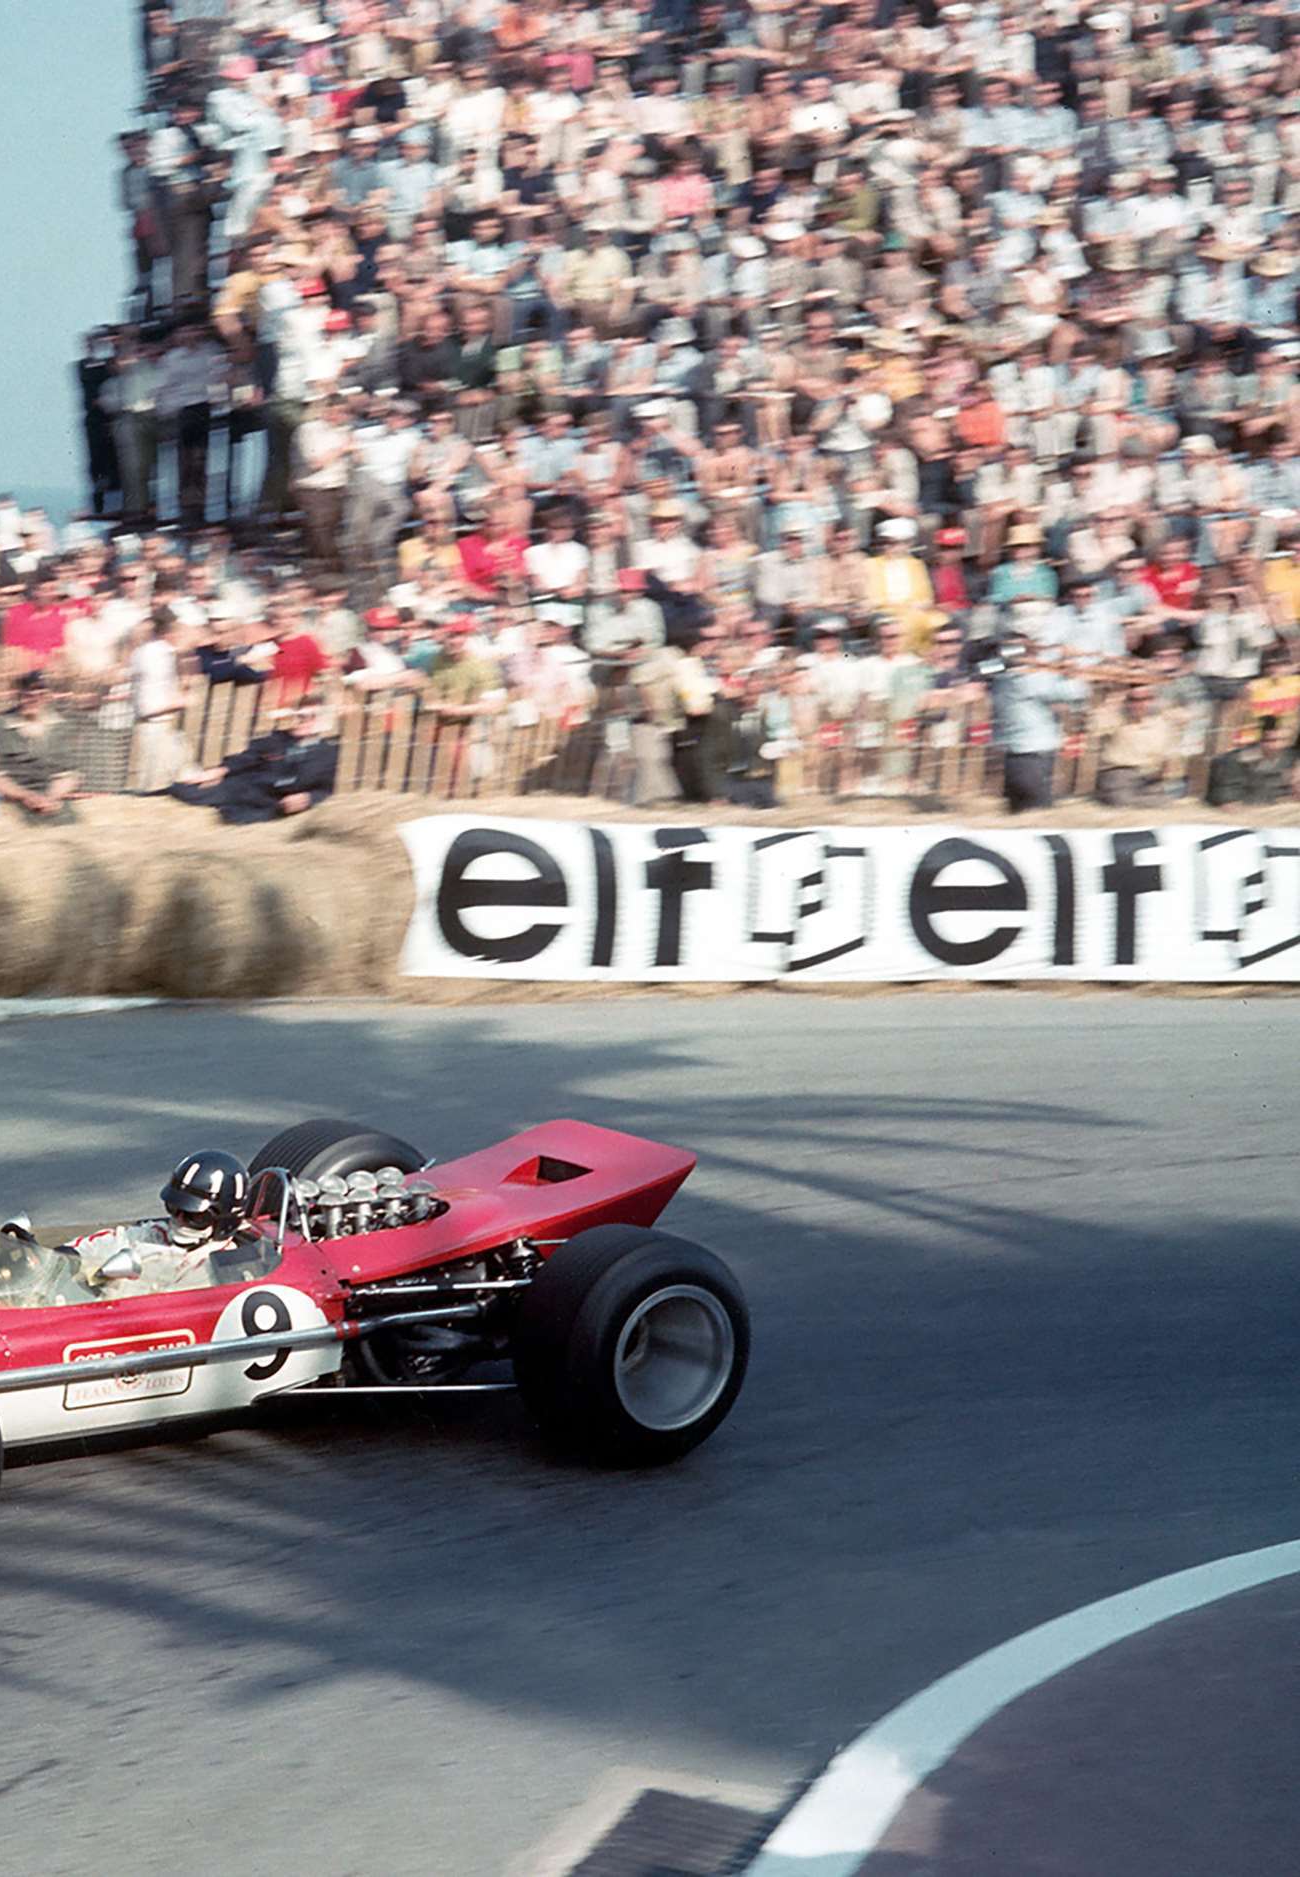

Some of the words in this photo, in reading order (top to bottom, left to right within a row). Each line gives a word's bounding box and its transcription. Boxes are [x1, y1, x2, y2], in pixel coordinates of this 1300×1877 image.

[437, 826, 714, 968] elf
[909, 830, 1165, 968] elf
[145, 1375, 186, 1391] LOTUS
[241, 1290, 293, 1381] 9
